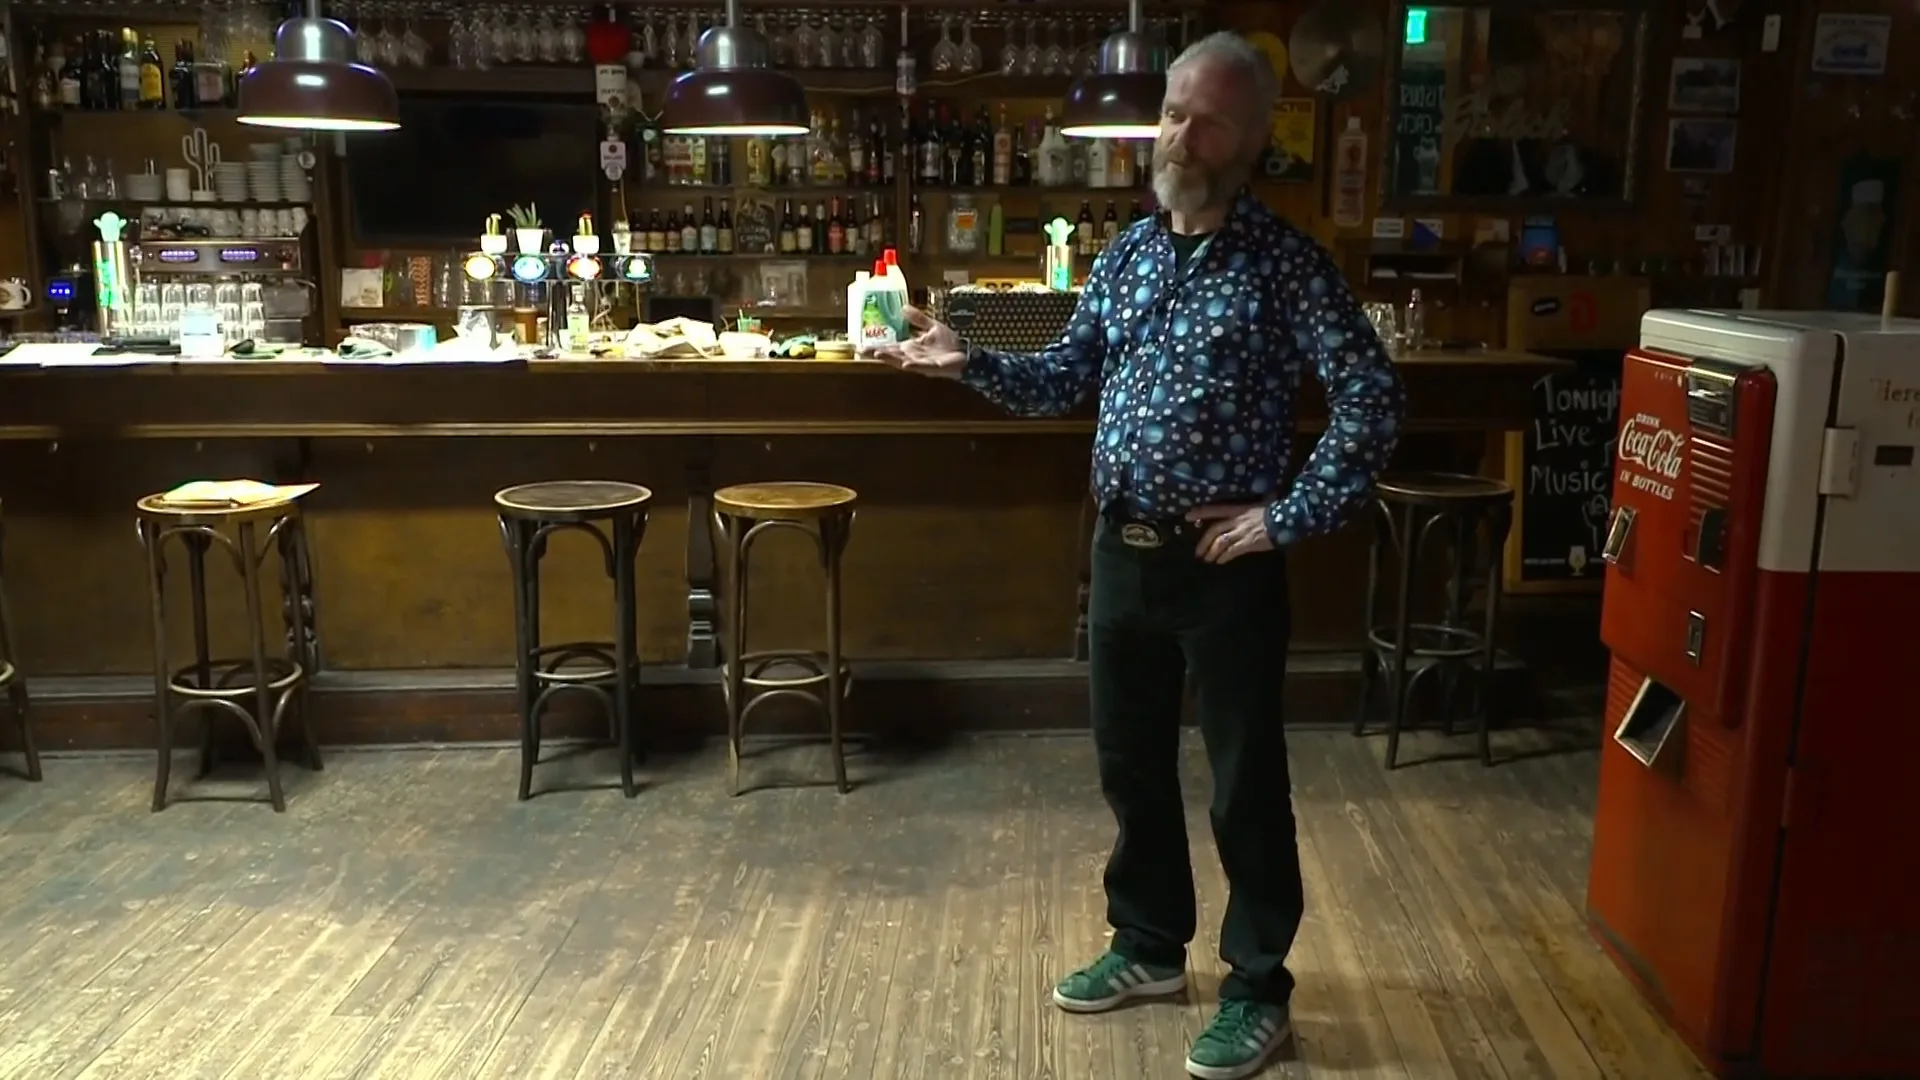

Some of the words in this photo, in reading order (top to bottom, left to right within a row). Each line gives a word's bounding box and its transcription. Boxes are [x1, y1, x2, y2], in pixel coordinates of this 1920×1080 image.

[1535, 418, 1591, 451] Live
[1635, 412, 1660, 428] DRINK
[1528, 460, 1607, 496] Music
[1620, 470, 1631, 483] IN
[1632, 474, 1674, 500] BOTTLES
